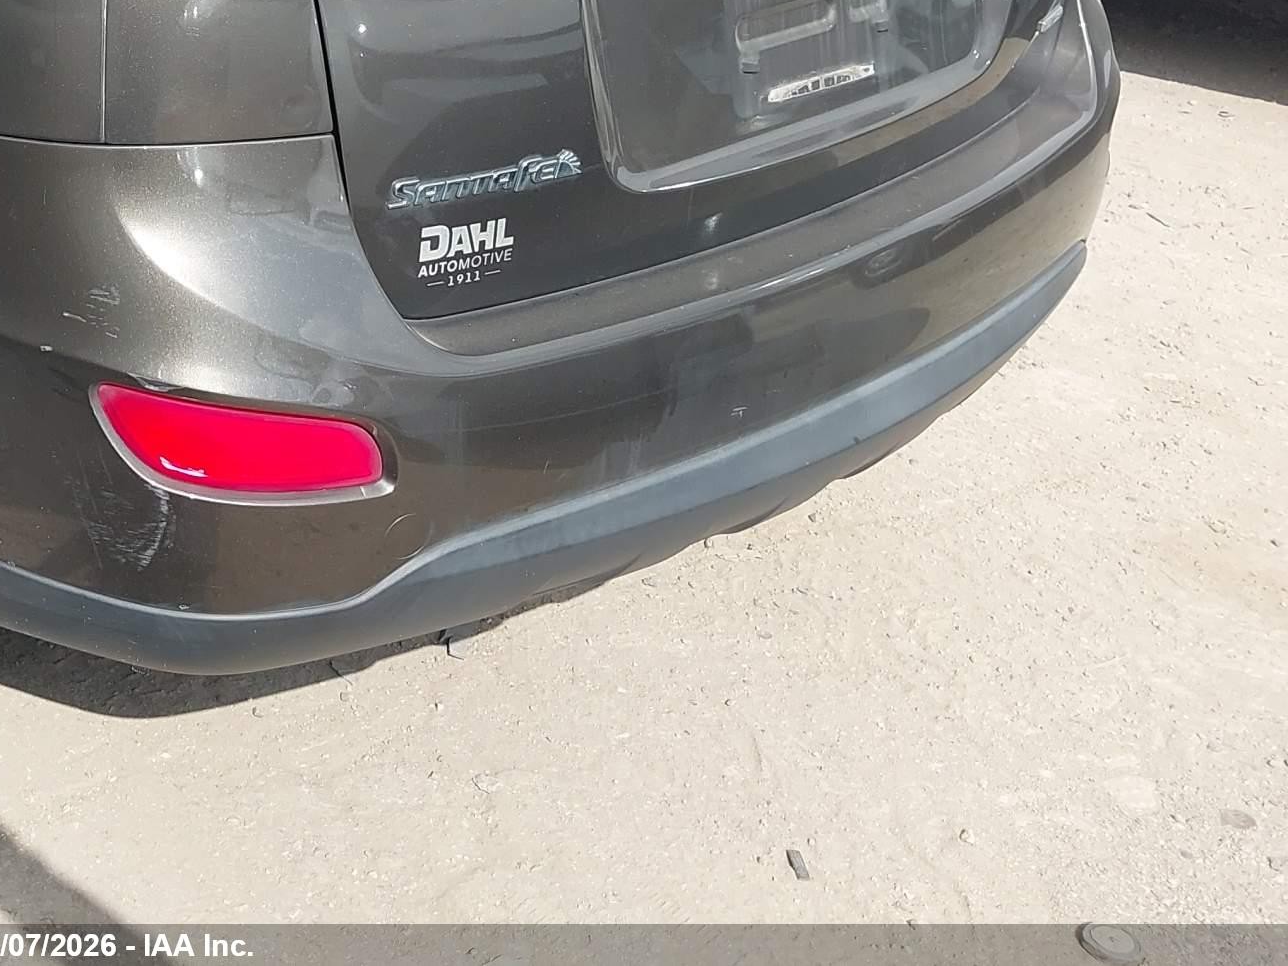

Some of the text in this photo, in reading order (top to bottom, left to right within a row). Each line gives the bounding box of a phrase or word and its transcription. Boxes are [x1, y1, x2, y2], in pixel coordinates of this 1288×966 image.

[418, 217, 514, 263] DAHL
[418, 247, 513, 278] AUTOMOTIVE
[447, 270, 481, 287] 1911
